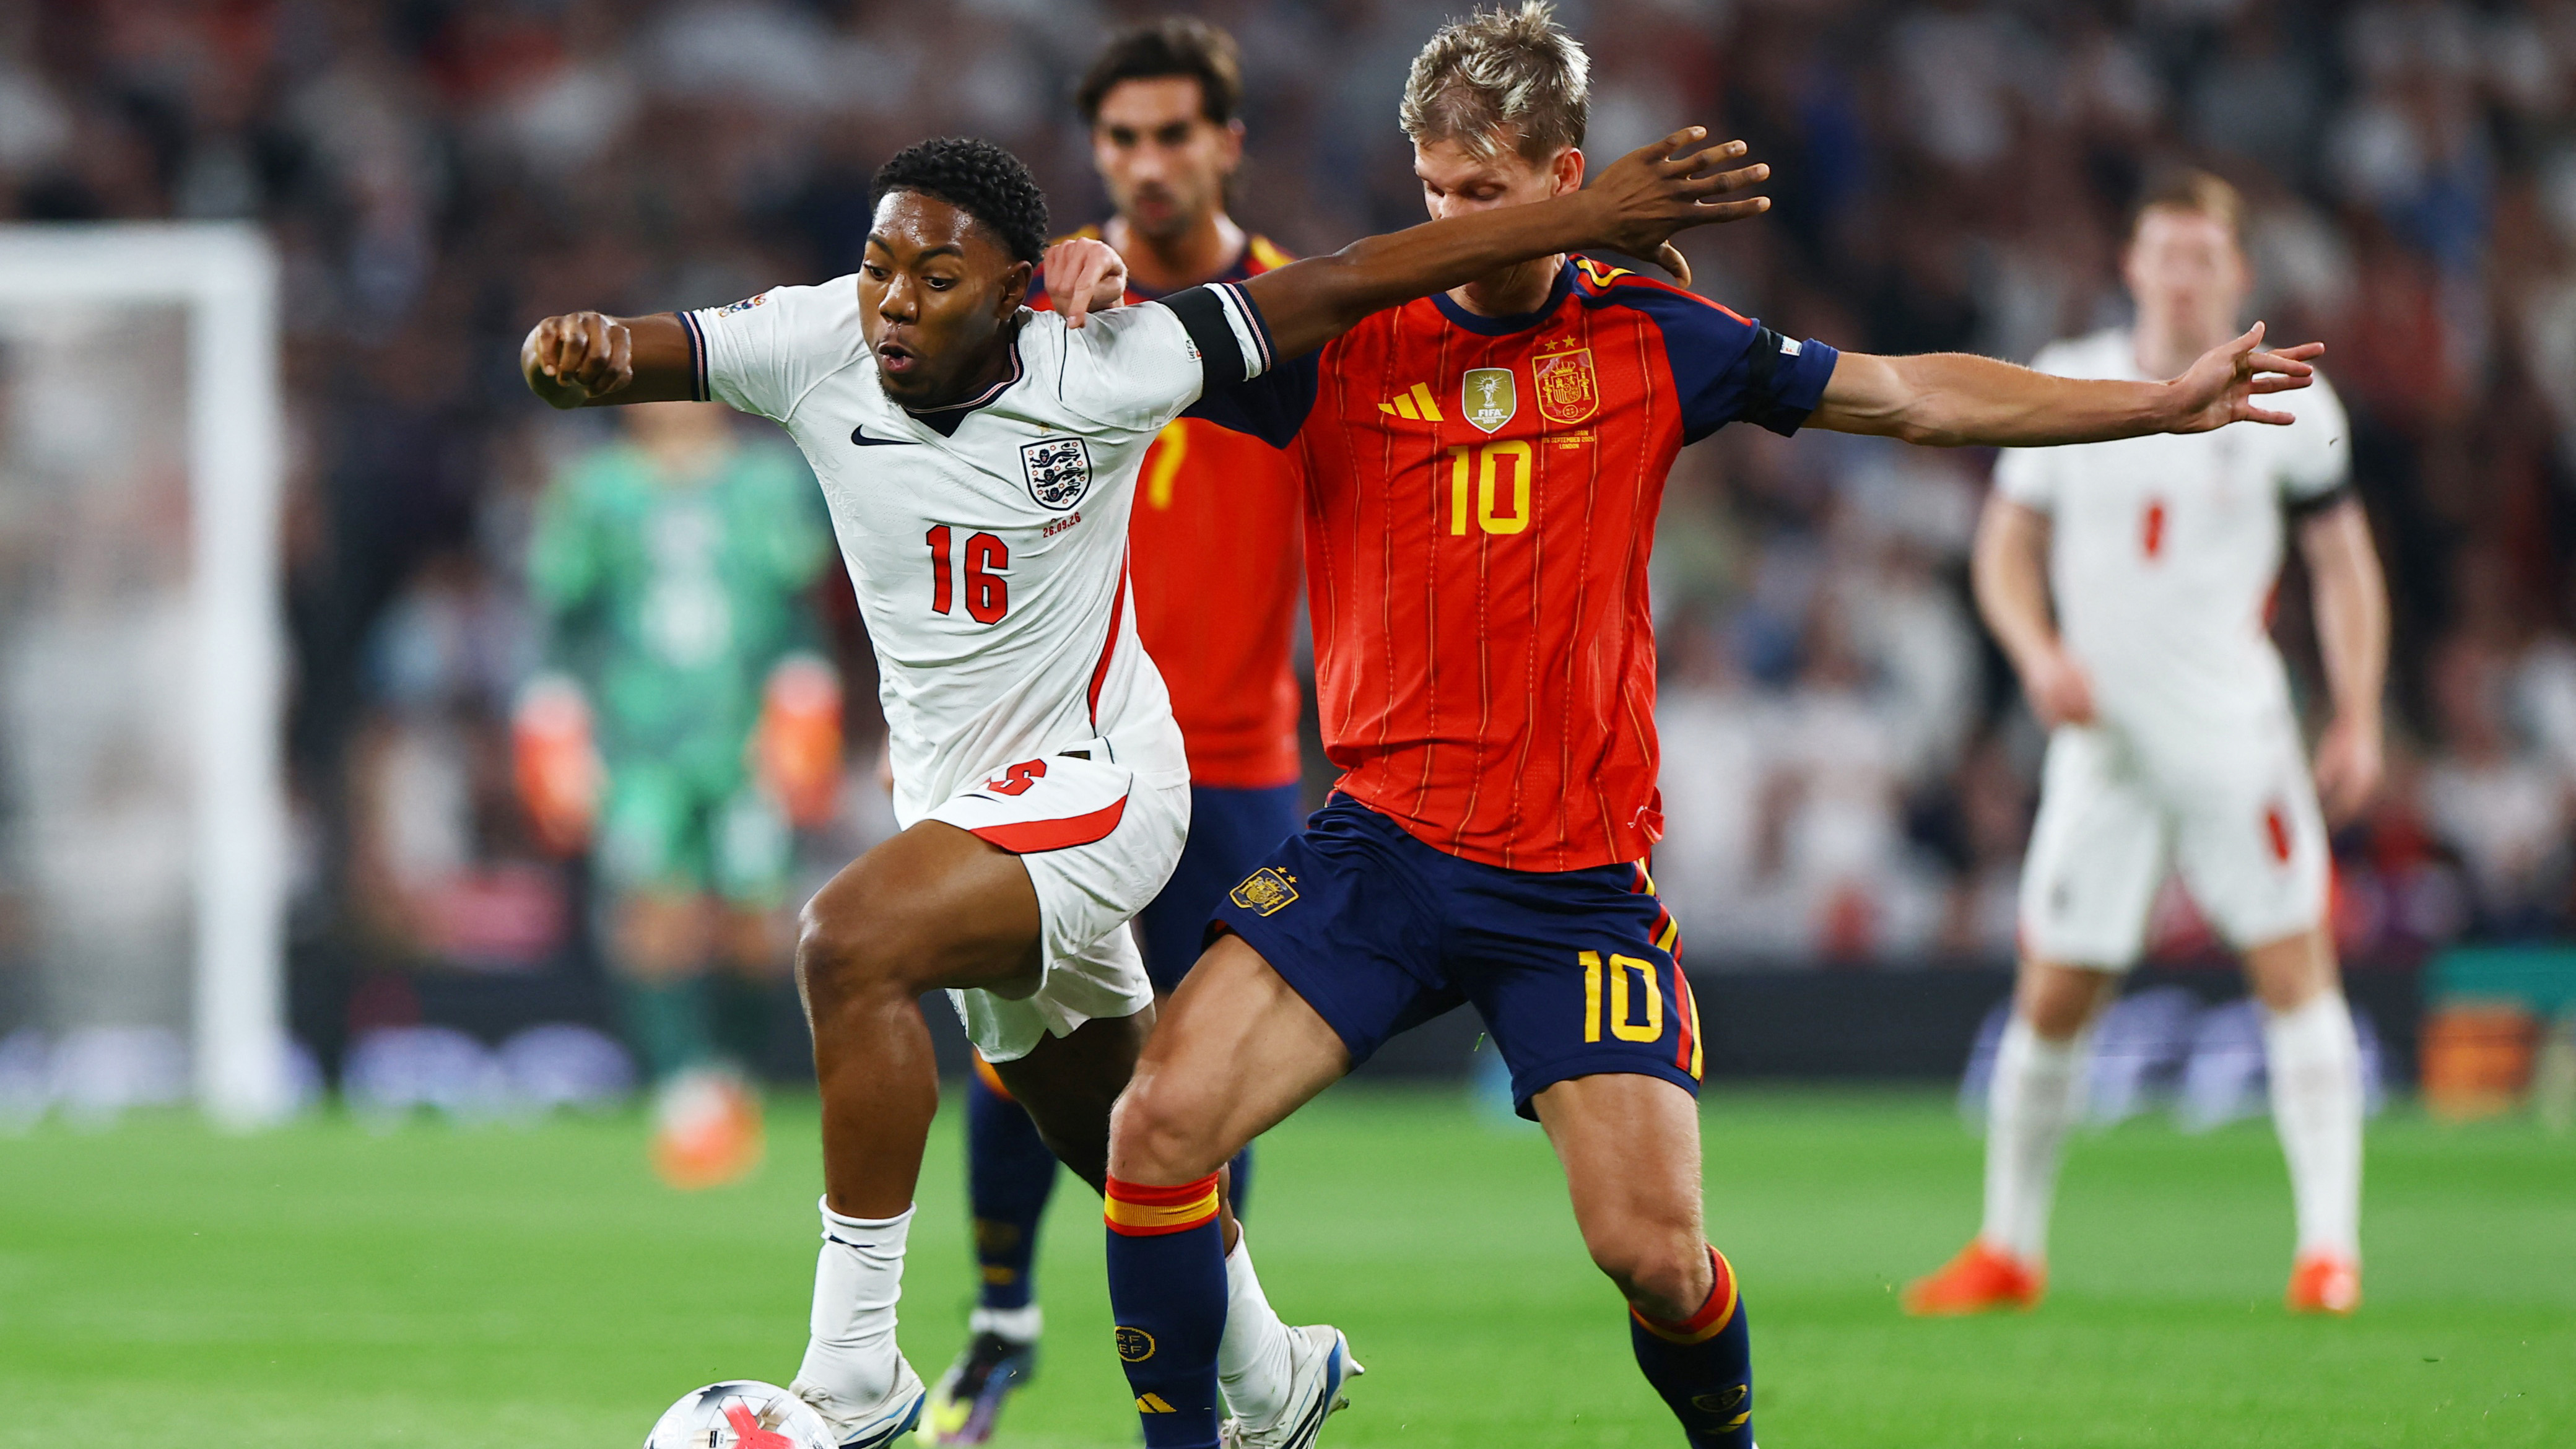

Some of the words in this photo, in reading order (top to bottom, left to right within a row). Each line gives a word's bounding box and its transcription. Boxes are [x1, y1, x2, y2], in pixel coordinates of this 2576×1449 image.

[1186, 339, 1195, 359] UEFA
[1478, 408, 1501, 417] FIFA
[1447, 440, 1532, 536] 10
[1043, 511, 1081, 538] 26.09.26
[926, 524, 1009, 625] 16
[1578, 951, 1663, 1043] 10
